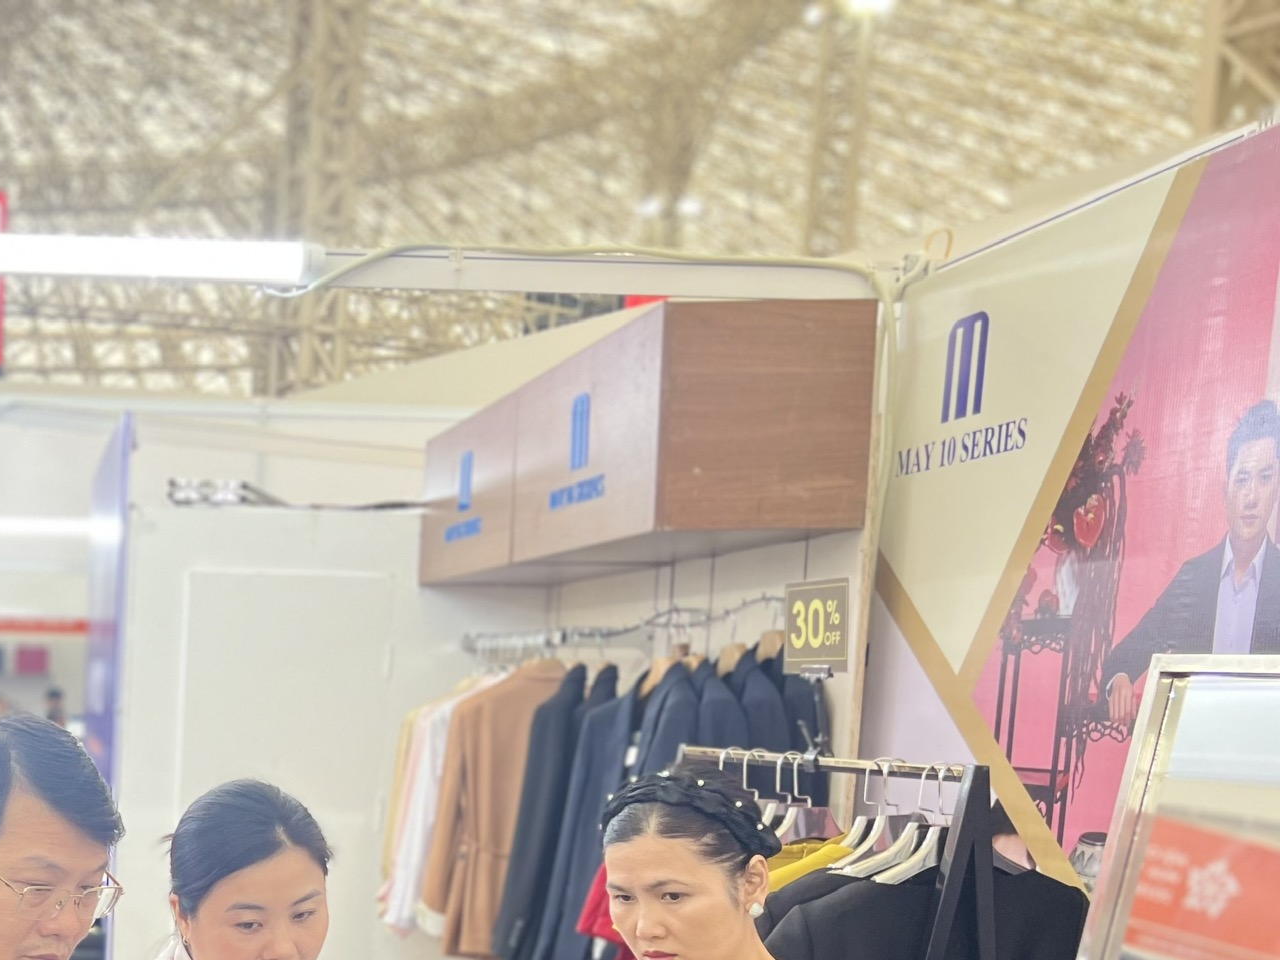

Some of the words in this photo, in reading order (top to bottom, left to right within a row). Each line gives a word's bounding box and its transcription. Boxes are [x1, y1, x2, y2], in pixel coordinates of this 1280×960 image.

[895, 441, 935, 478] MAY
[938, 436, 957, 468] 10
[959, 418, 1028, 464] SERIES
[824, 631, 841, 646] OFF
